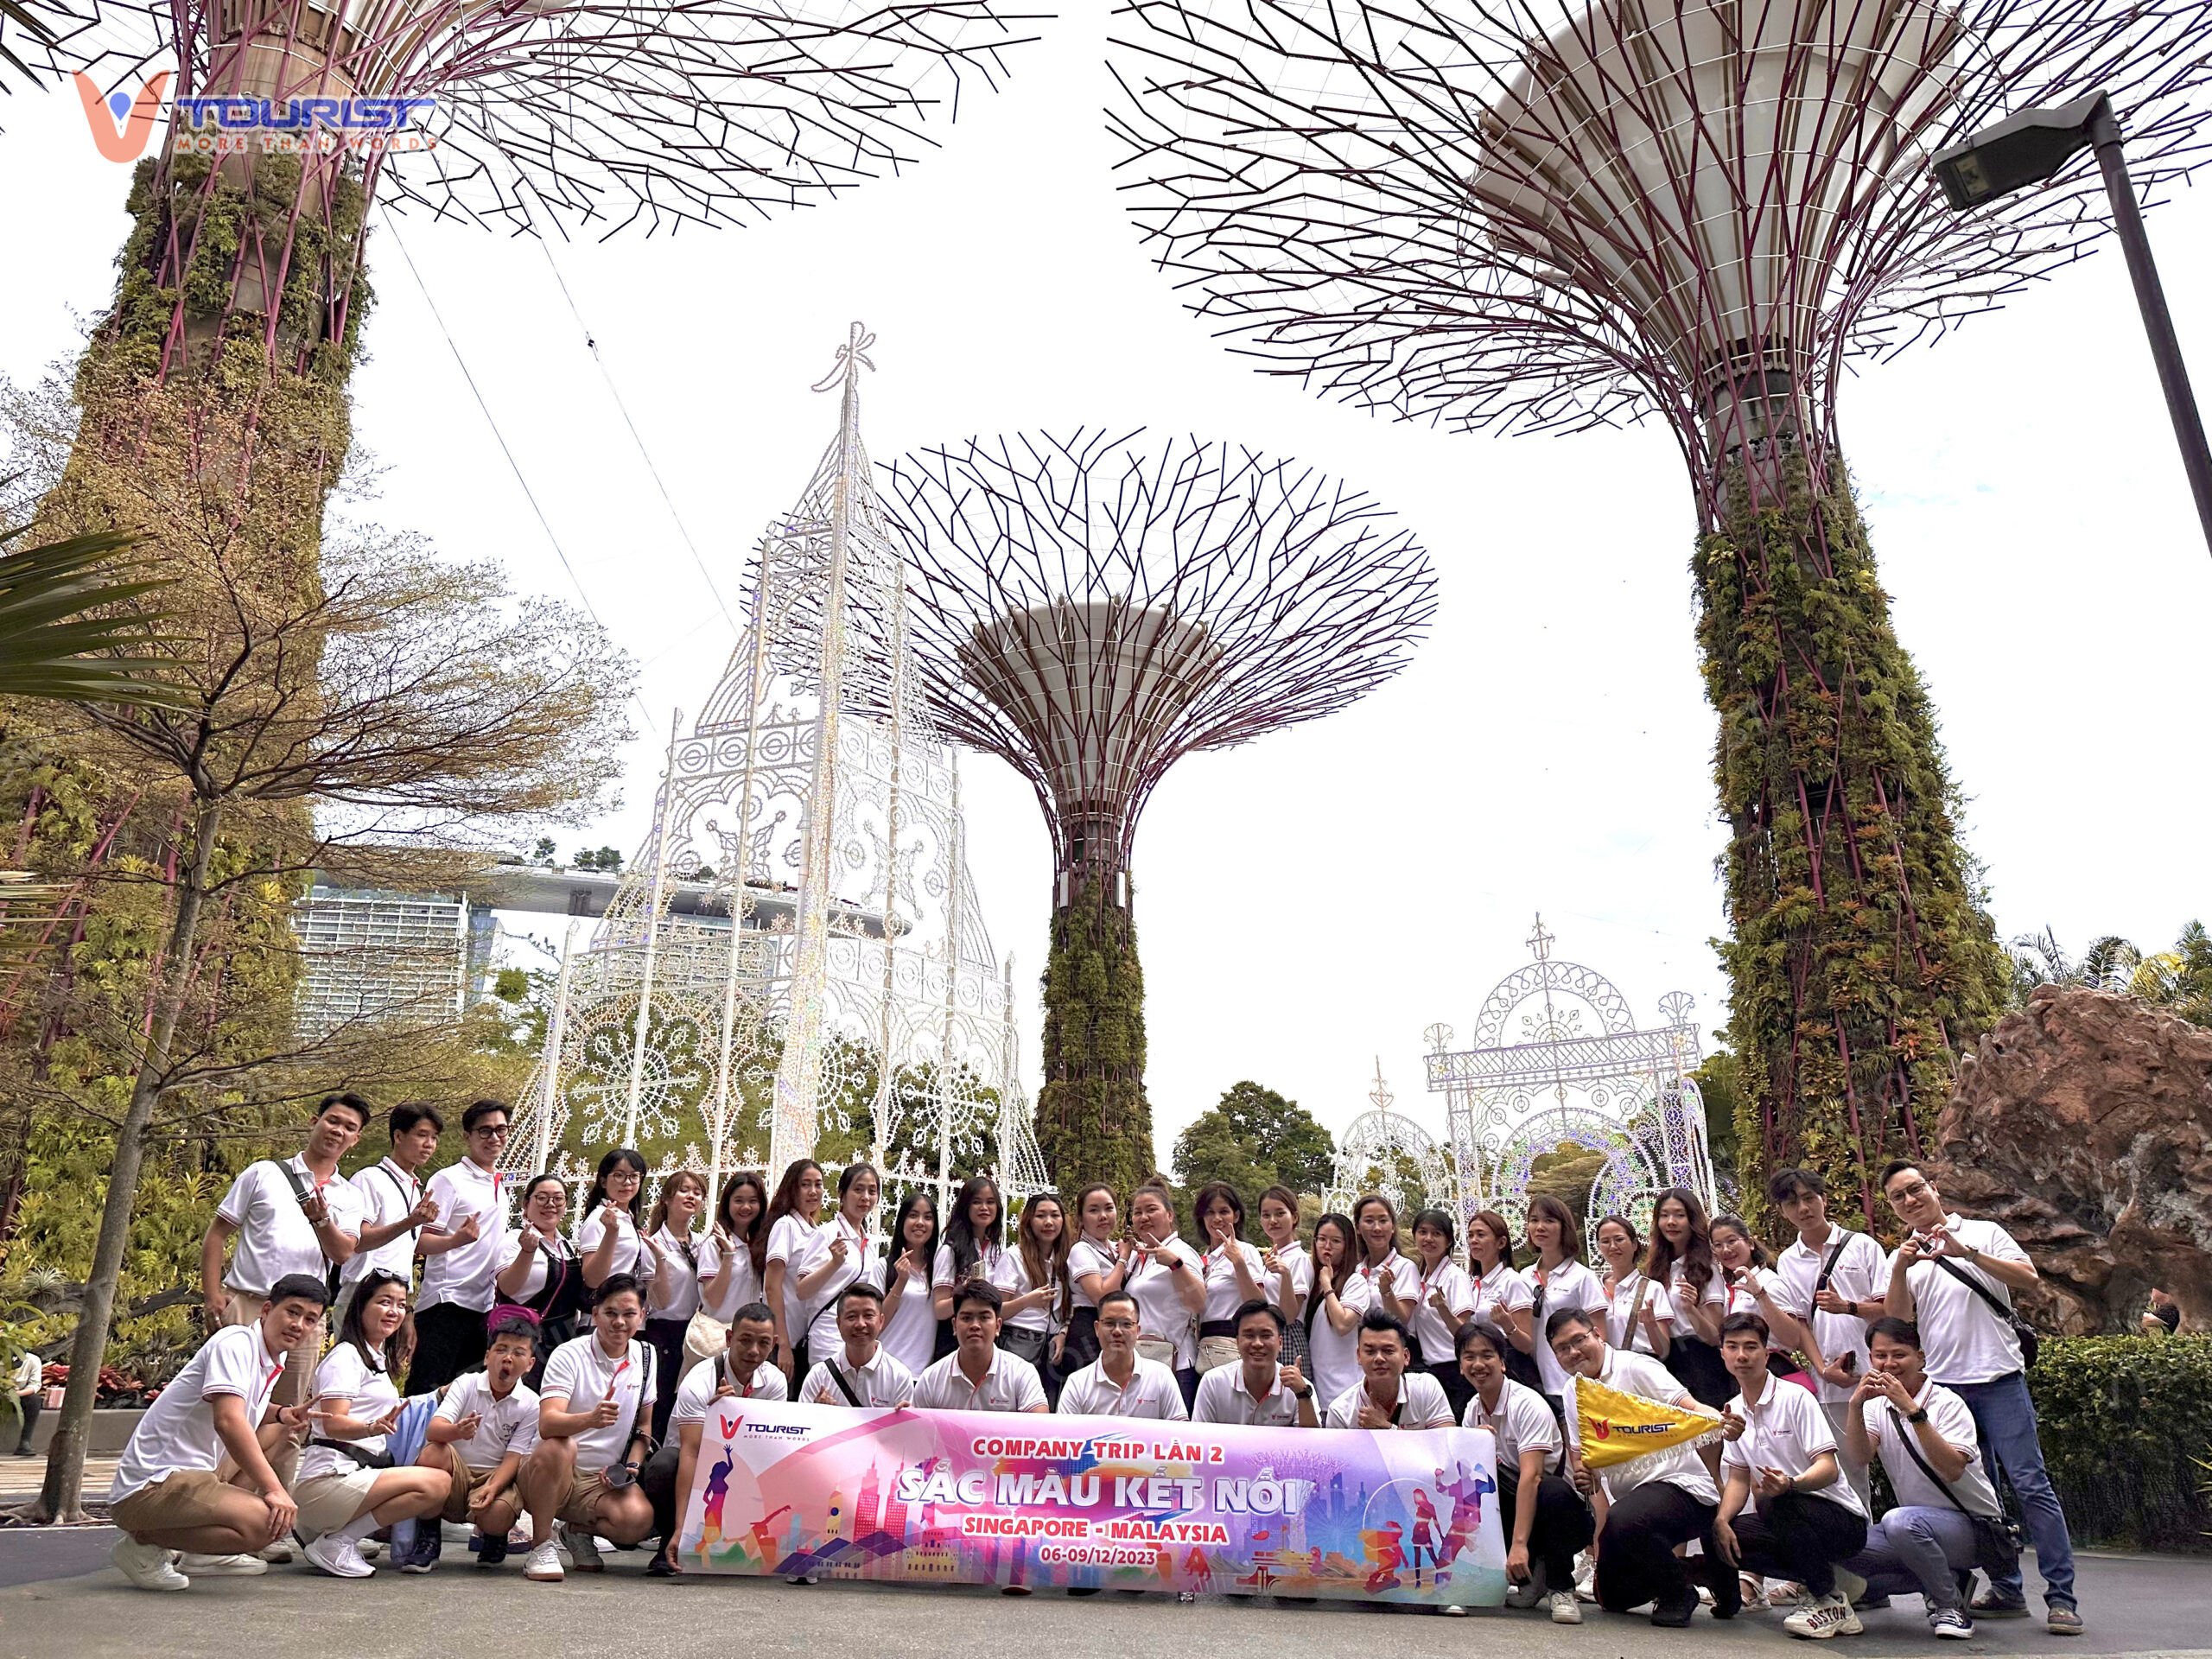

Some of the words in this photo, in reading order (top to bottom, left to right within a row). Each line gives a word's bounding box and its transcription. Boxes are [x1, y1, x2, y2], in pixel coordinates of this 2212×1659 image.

[746, 1423, 811, 1435] TOURIST
[1611, 1422, 1676, 1434] TOURIST
[973, 1438, 1084, 1458] COMPANY
[1094, 1441, 1144, 1459] TRIP
[1211, 1446, 1224, 1462] 2
[897, 1460, 985, 1504] SẮC
[996, 1467, 1101, 1510] MÀU
[1115, 1466, 1203, 1510] KẾT
[1214, 1467, 1300, 1516] NỐI
[963, 1516, 1089, 1538] SINGAPORE
[1110, 1522, 1228, 1543] MALAYSIA
[1040, 1547, 1155, 1567] 06-09/12/2023
[1806, 1606, 1847, 1630] BOSTON
